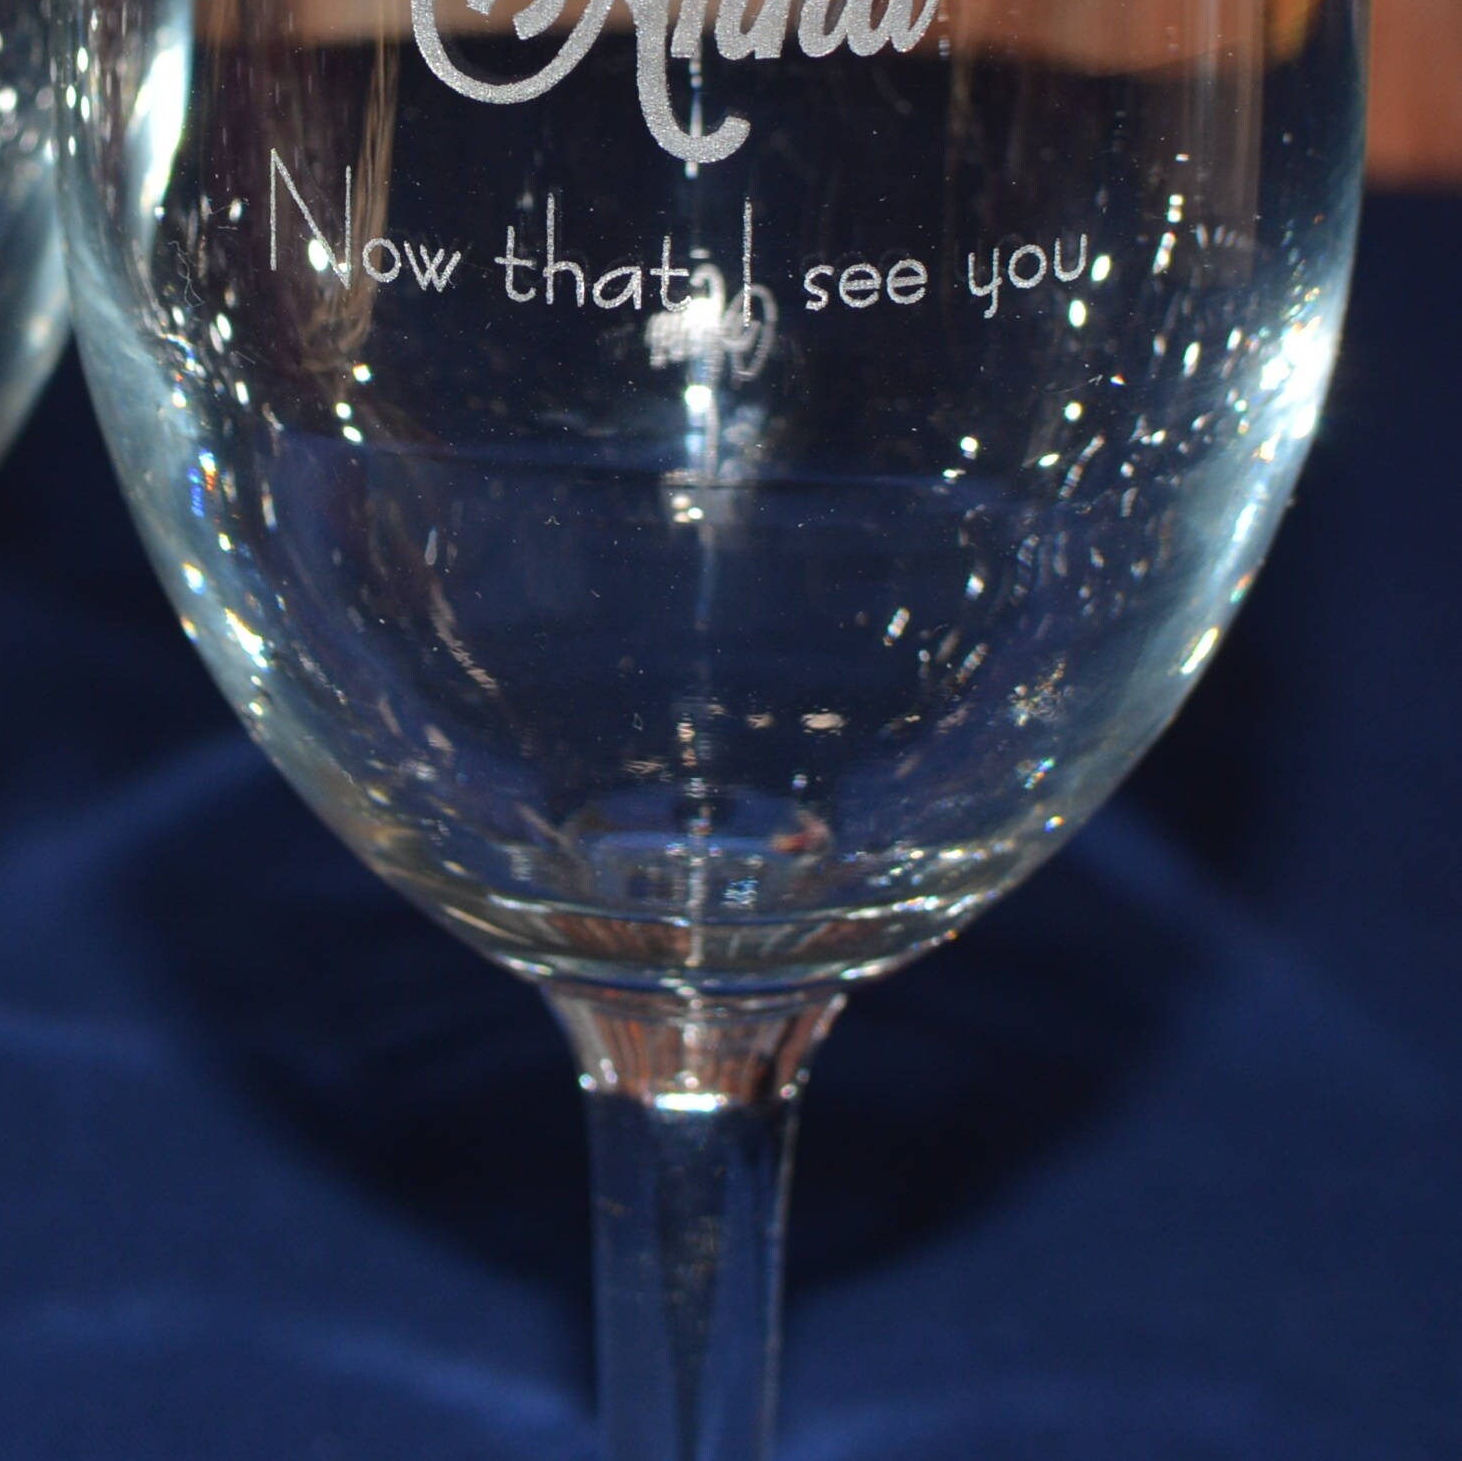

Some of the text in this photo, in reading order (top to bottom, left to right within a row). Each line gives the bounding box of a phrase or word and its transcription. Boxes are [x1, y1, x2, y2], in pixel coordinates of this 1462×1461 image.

[269, 146, 462, 293] Now
[493, 191, 694, 313] that
[741, 199, 755, 328] I
[803, 257, 930, 312] see
[967, 233, 1089, 319] you
